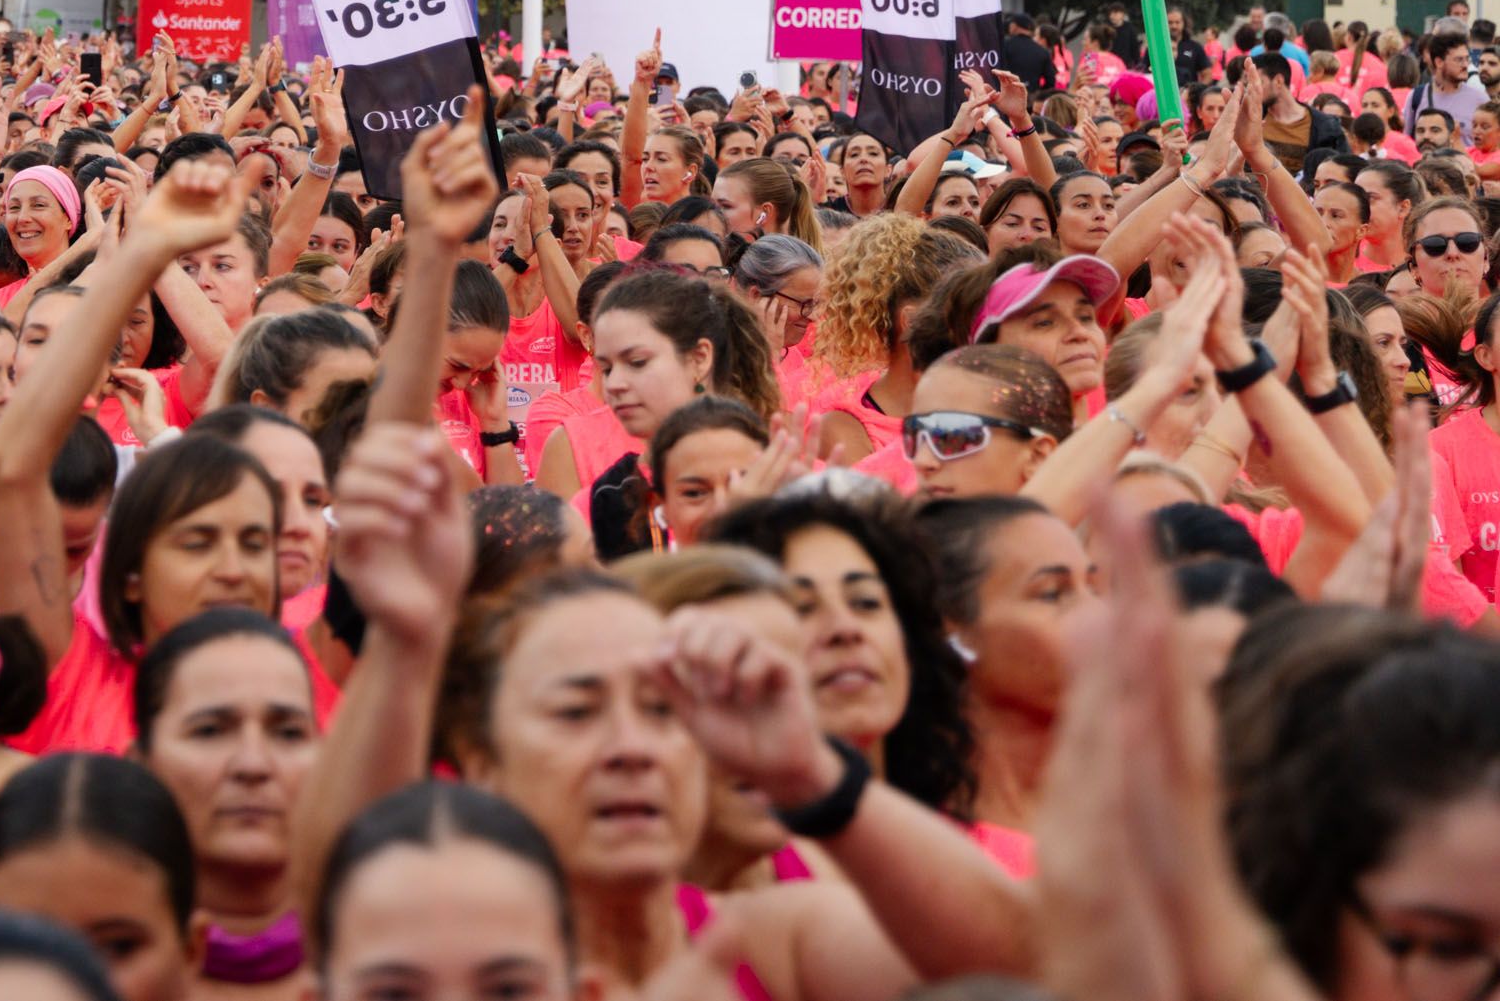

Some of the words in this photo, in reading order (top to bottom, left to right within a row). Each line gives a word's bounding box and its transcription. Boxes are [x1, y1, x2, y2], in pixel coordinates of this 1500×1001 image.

[169, 14, 241, 31] Santander
[776, 6, 863, 30] CORRED
[1471, 492, 1500, 505] OYS
[1480, 521, 1500, 552] C
